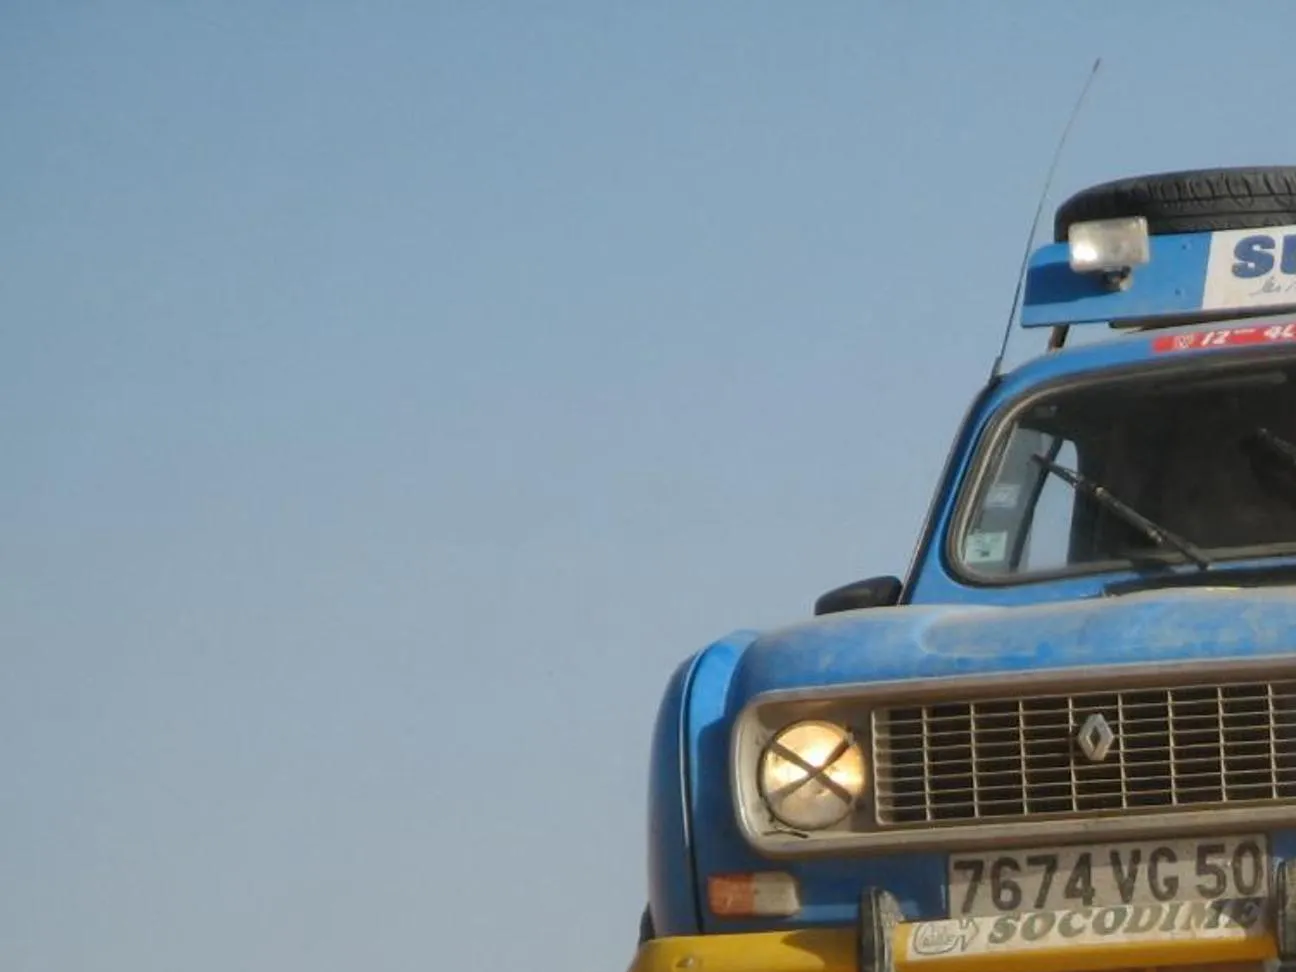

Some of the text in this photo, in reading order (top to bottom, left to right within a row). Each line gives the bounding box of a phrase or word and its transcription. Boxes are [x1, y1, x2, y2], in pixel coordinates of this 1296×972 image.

[1264, 323, 1296, 340] 4L
[953, 840, 1263, 914] 7674 VG 50
[988, 896, 1261, 945] SOCODIME
